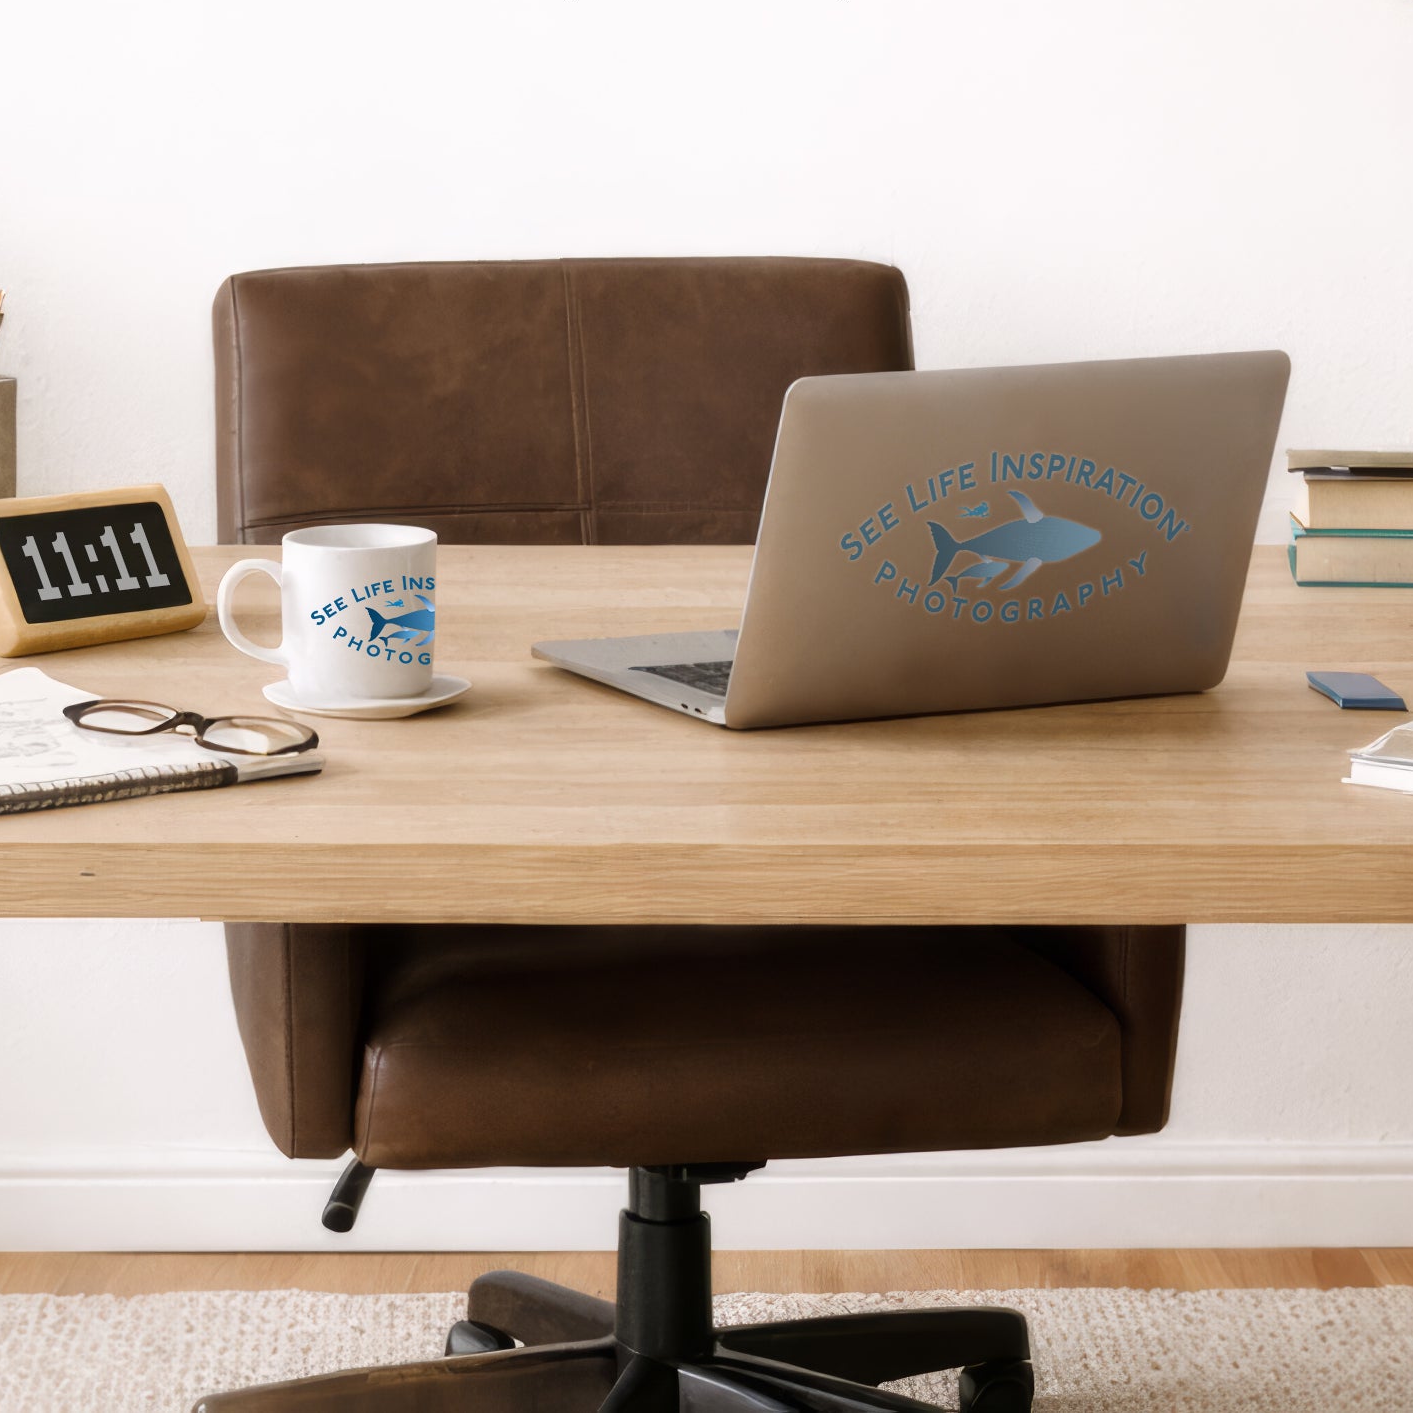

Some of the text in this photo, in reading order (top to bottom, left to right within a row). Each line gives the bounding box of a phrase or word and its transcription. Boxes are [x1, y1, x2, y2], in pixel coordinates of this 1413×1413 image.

[840, 451, 1187, 561] SEE LIFE INSPIRATION
[21, 522, 171, 601] 11:11
[874, 551, 1147, 623] PHOTOGRAPHY
[310, 596, 348, 626] SEE
[350, 579, 395, 603] LIFE
[332, 625, 431, 666] PHOTOG
